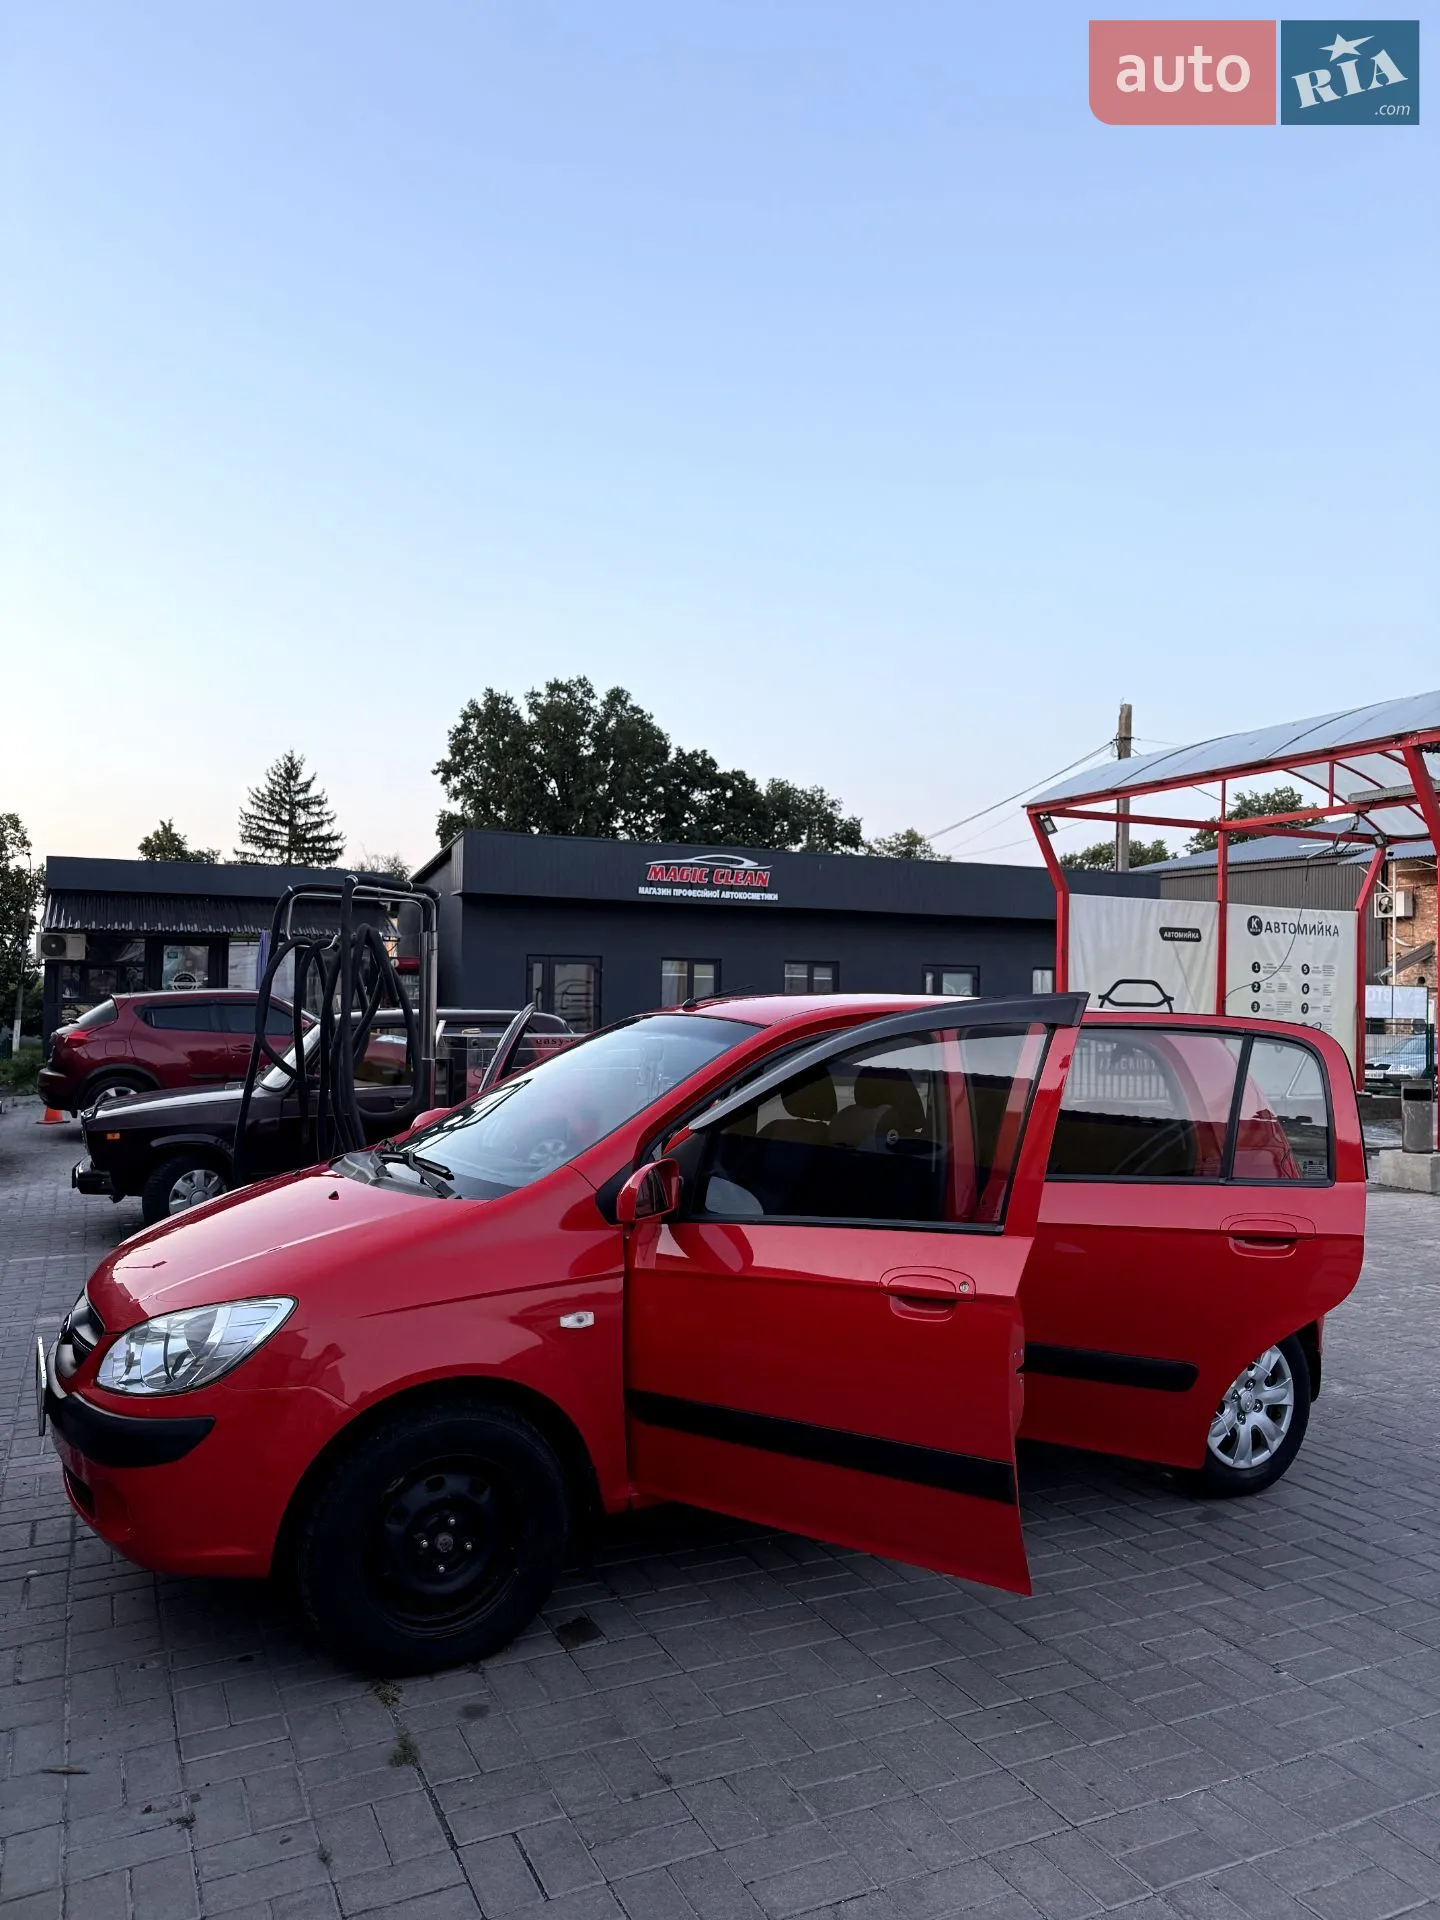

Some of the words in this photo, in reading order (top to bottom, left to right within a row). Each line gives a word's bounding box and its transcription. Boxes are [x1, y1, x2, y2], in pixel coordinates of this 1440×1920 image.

[647, 865, 709, 884] MAGIC
[713, 868, 770, 887] CLEAN
[638, 886, 672, 897] МАГАЗИН
[673, 888, 720, 899] ПРОФЕСІЙНОЇ
[721, 891, 779, 901] АВТОКОСМЕТИКИ
[1163, 930, 1200, 940] АВТОМИЙКА
[1264, 921, 1340, 937] АВТОМИЙКА
